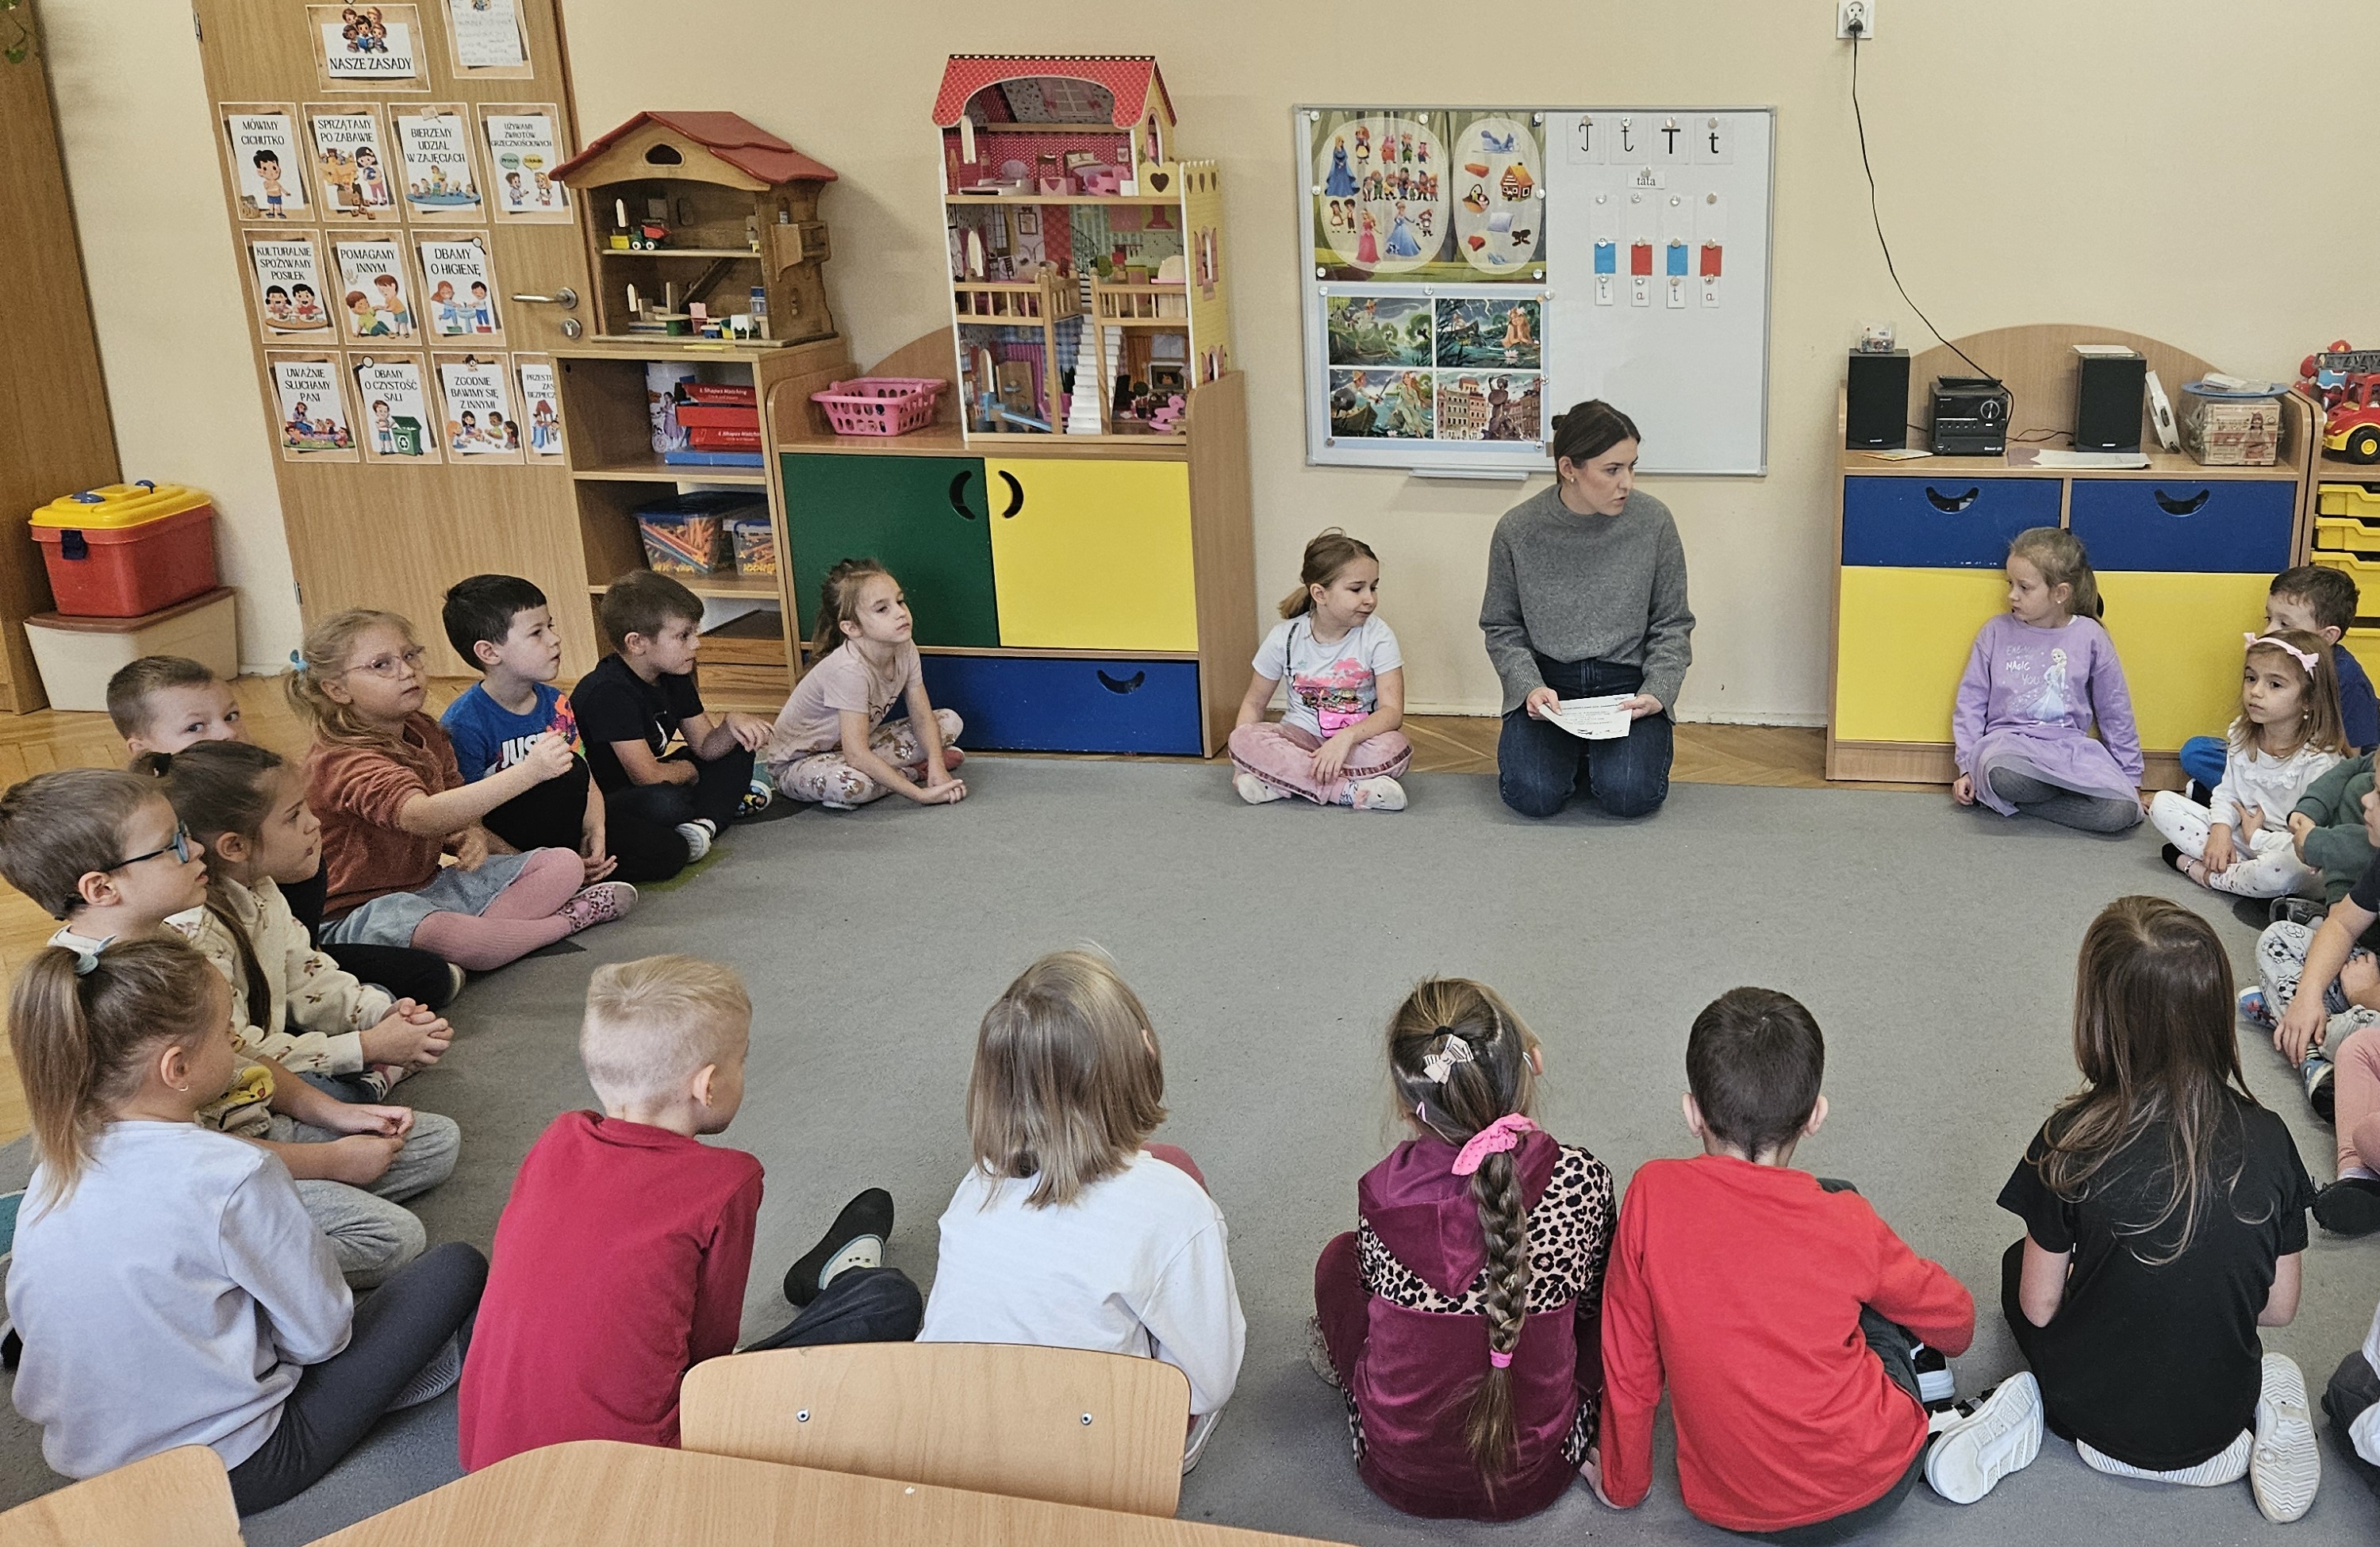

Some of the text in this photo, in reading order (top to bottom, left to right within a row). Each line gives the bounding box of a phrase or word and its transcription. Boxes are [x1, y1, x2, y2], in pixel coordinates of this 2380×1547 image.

[329, 57, 411, 70] NASZE ZASADY
[242, 118, 278, 130] MÓWIMY
[317, 119, 371, 131] SPRZĄTAMY
[321, 132, 374, 142] PO ZABAWIE
[411, 128, 451, 138] BIERZEMY
[240, 135, 285, 145] CICHUTKO
[1661, 129, 1680, 154] T
[1709, 132, 1719, 154] t
[406, 153, 466, 164] W ZAJĘCIACH
[255, 247, 312, 256] KULTURALNIE
[340, 249, 394, 259] POMAGAMY
[434, 248, 470, 259] DBAMY
[260, 257, 311, 268] SPOŻYWAMY
[356, 263, 387, 273] INNYM
[431, 263, 482, 277] O HIGIENĘ
[374, 369, 403, 378] DBAMY
[364, 378, 418, 390] O CZYSTOŚĆ
[454, 376, 492, 386] ZGODNIE
[300, 392, 321, 402] PANI
[383, 393, 403, 402] SALI
[451, 388, 499, 399] BAWIMY SIĘ
[459, 400, 466, 409] Z
[2022, 674, 2040, 685] YOU
